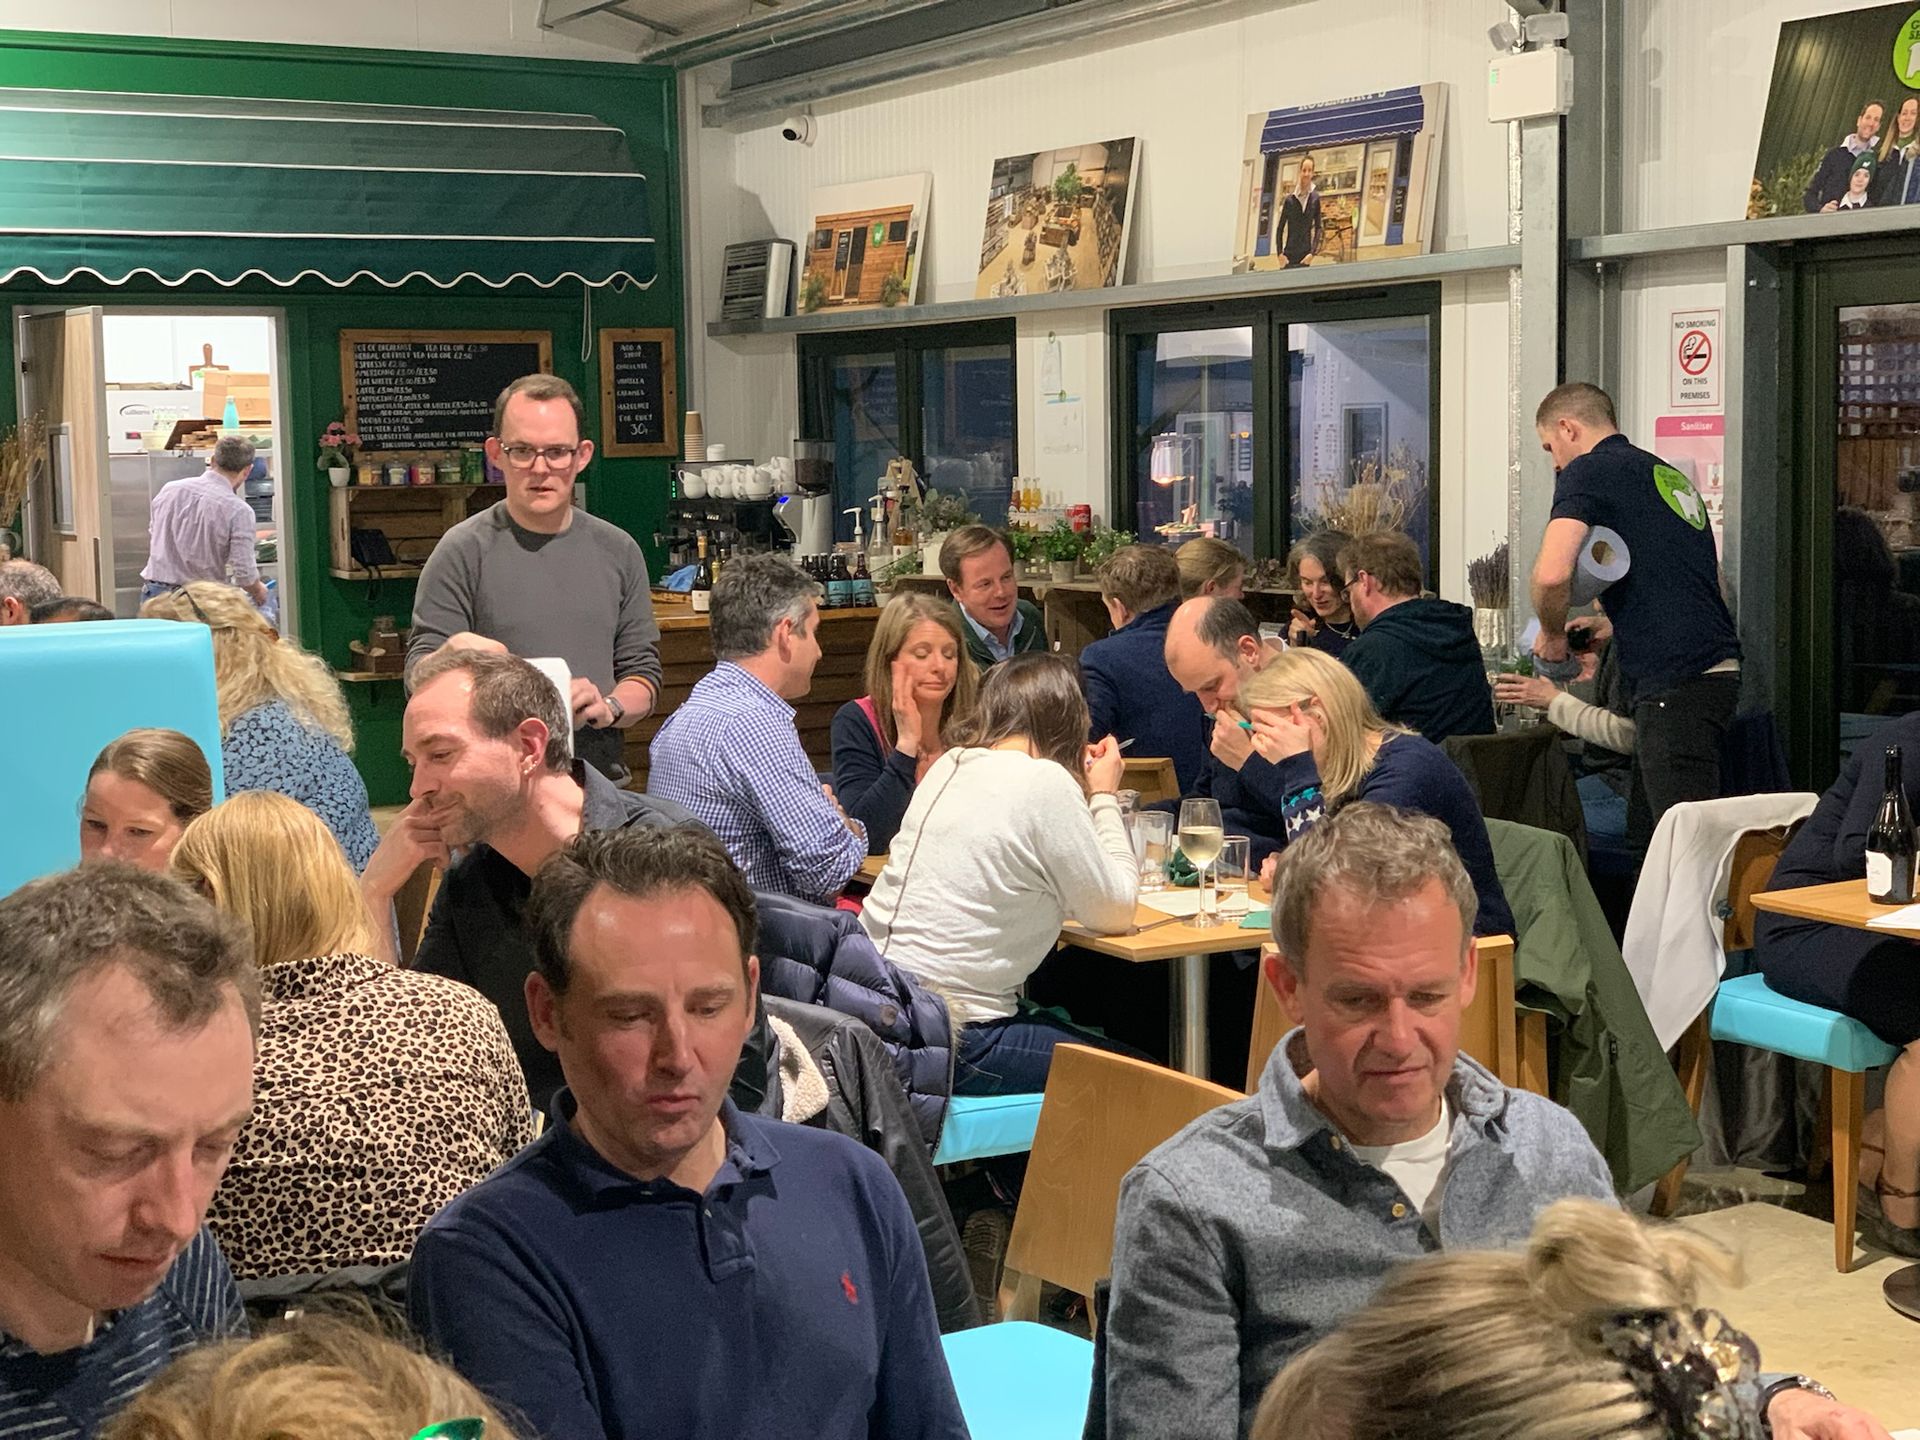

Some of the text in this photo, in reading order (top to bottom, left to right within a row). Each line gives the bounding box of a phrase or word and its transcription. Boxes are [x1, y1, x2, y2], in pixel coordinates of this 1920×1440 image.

[1686, 320, 1716, 329] SMOKING
[1682, 377, 1708, 386] ON THIS
[1680, 391, 1711, 400] PREMISES
[1680, 421, 1713, 432] Sanitiser
